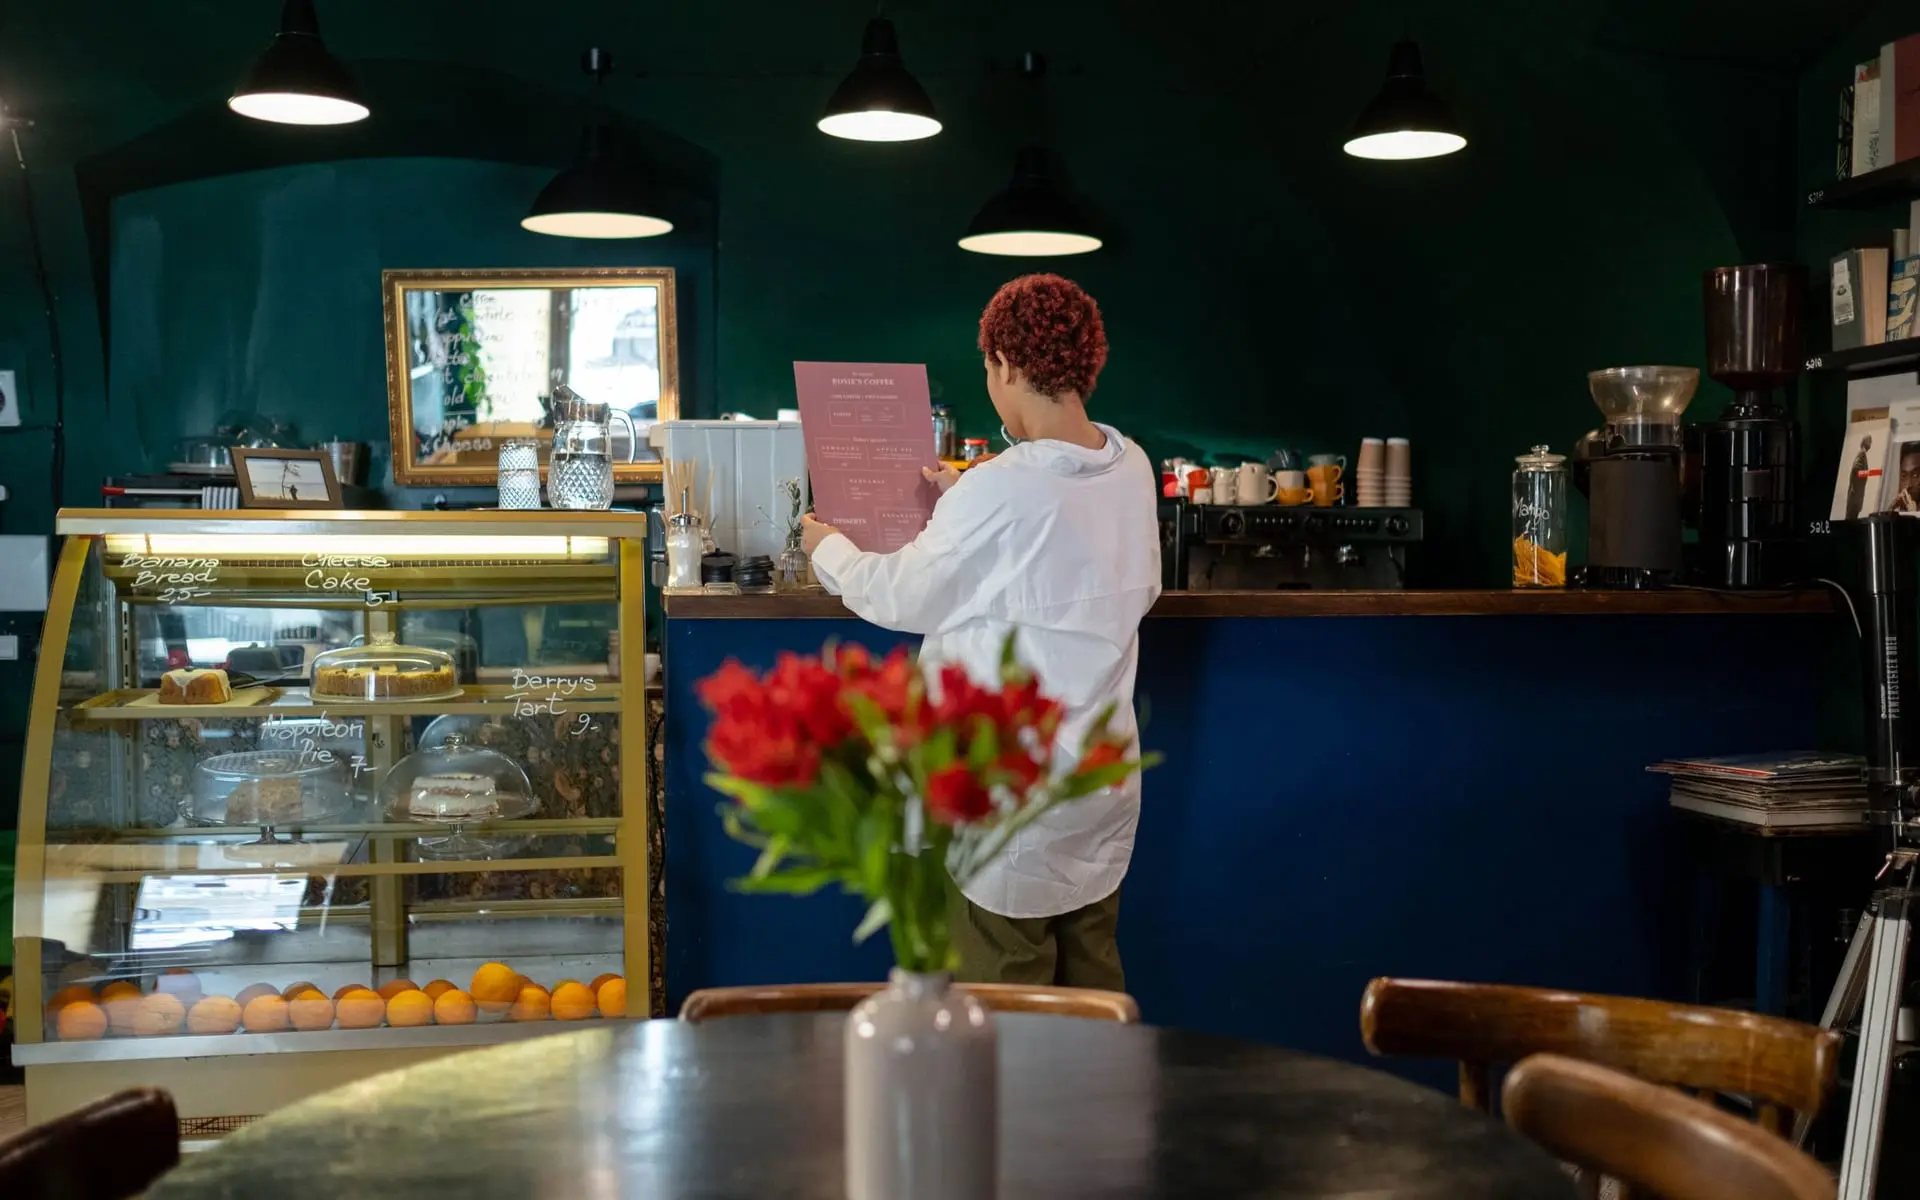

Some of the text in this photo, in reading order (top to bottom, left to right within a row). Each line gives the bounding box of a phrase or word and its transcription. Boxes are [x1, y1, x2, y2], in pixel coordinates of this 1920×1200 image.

[1805, 357, 1823, 370] sale
[863, 377, 895, 386] COFFEE
[1810, 520, 1831, 534] sale
[120, 552, 220, 569] Banana
[301, 551, 391, 568] Cheese
[131, 569, 217, 587] Bread
[305, 569, 373, 592] Cake
[511, 667, 597, 693] Berry's
[504, 691, 568, 721] Tart
[260, 710, 364, 746] Napoleon
[299, 738, 336, 764] Pie
